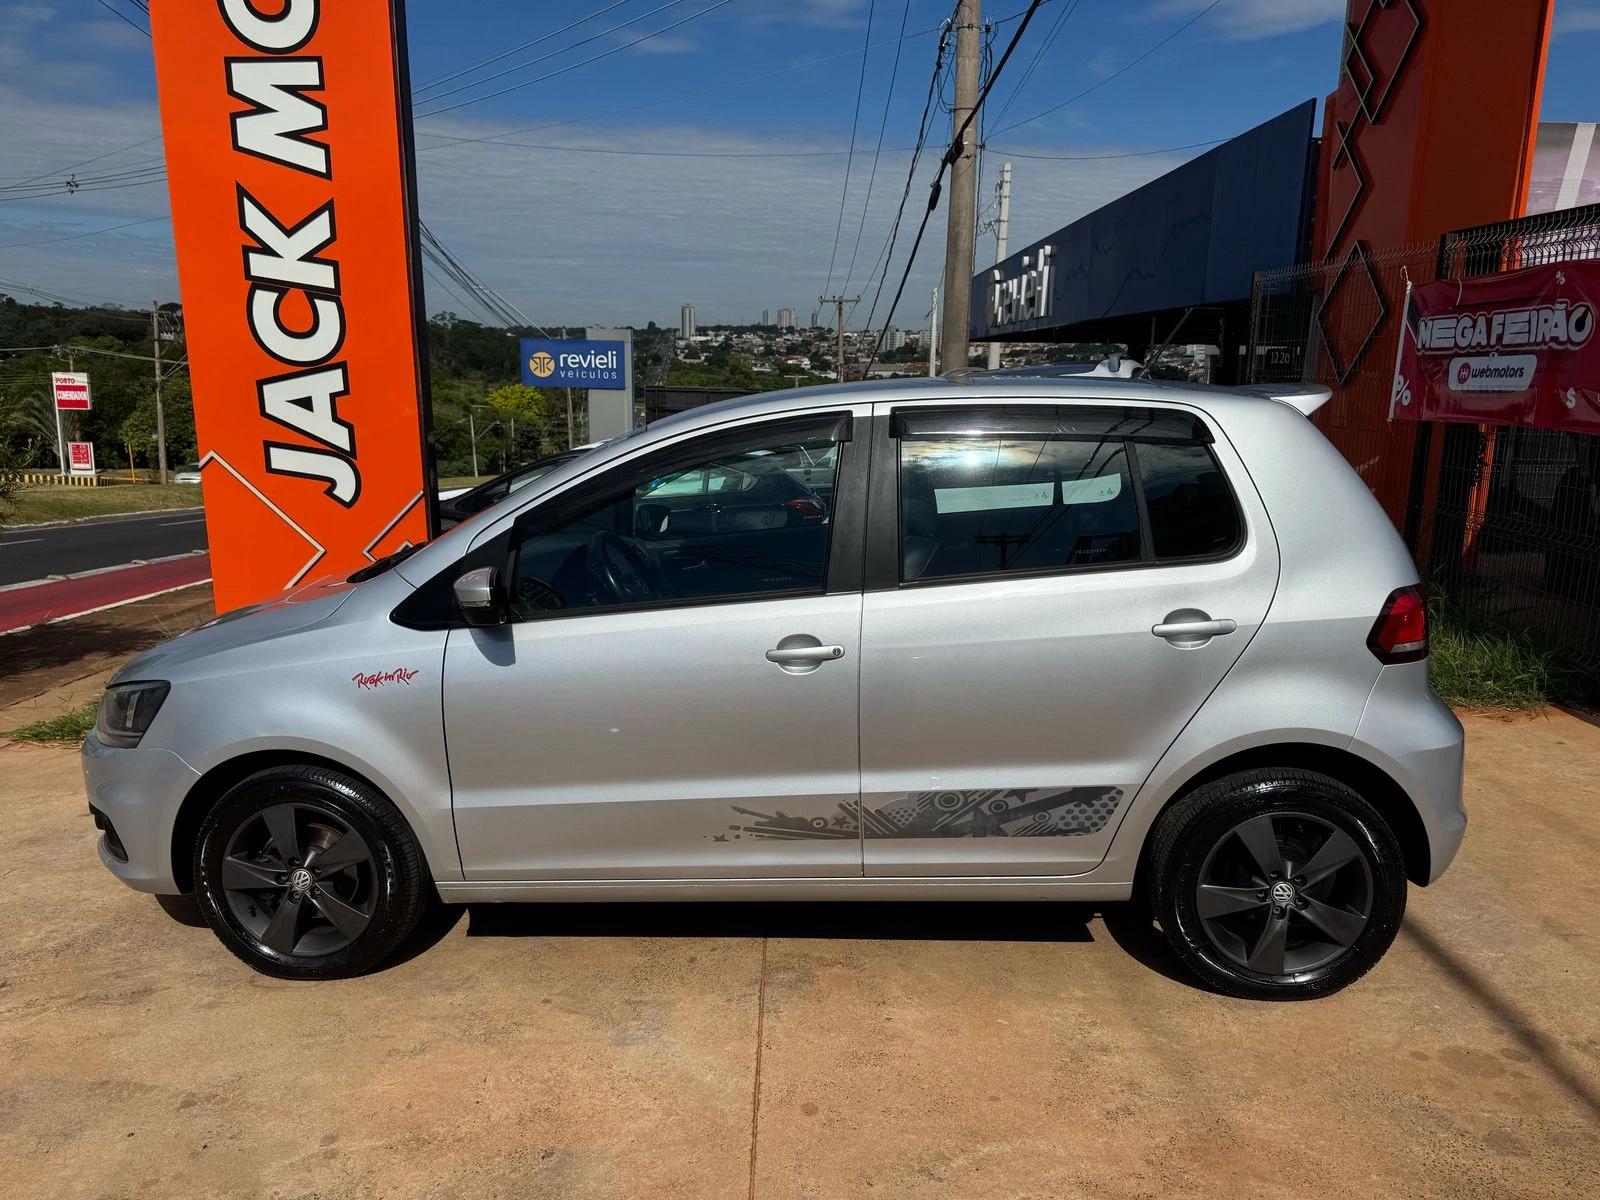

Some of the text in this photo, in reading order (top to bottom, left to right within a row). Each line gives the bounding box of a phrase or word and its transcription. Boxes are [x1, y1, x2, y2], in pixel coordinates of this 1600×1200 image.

[1417, 302, 1593, 350] MEGA FEIRÃO
[235, 180, 362, 509] JACK
[559, 350, 617, 369] revieli
[1471, 364, 1524, 380] webmotors
[352, 670, 385, 691] Rock
[393, 667, 419, 685] Rio
